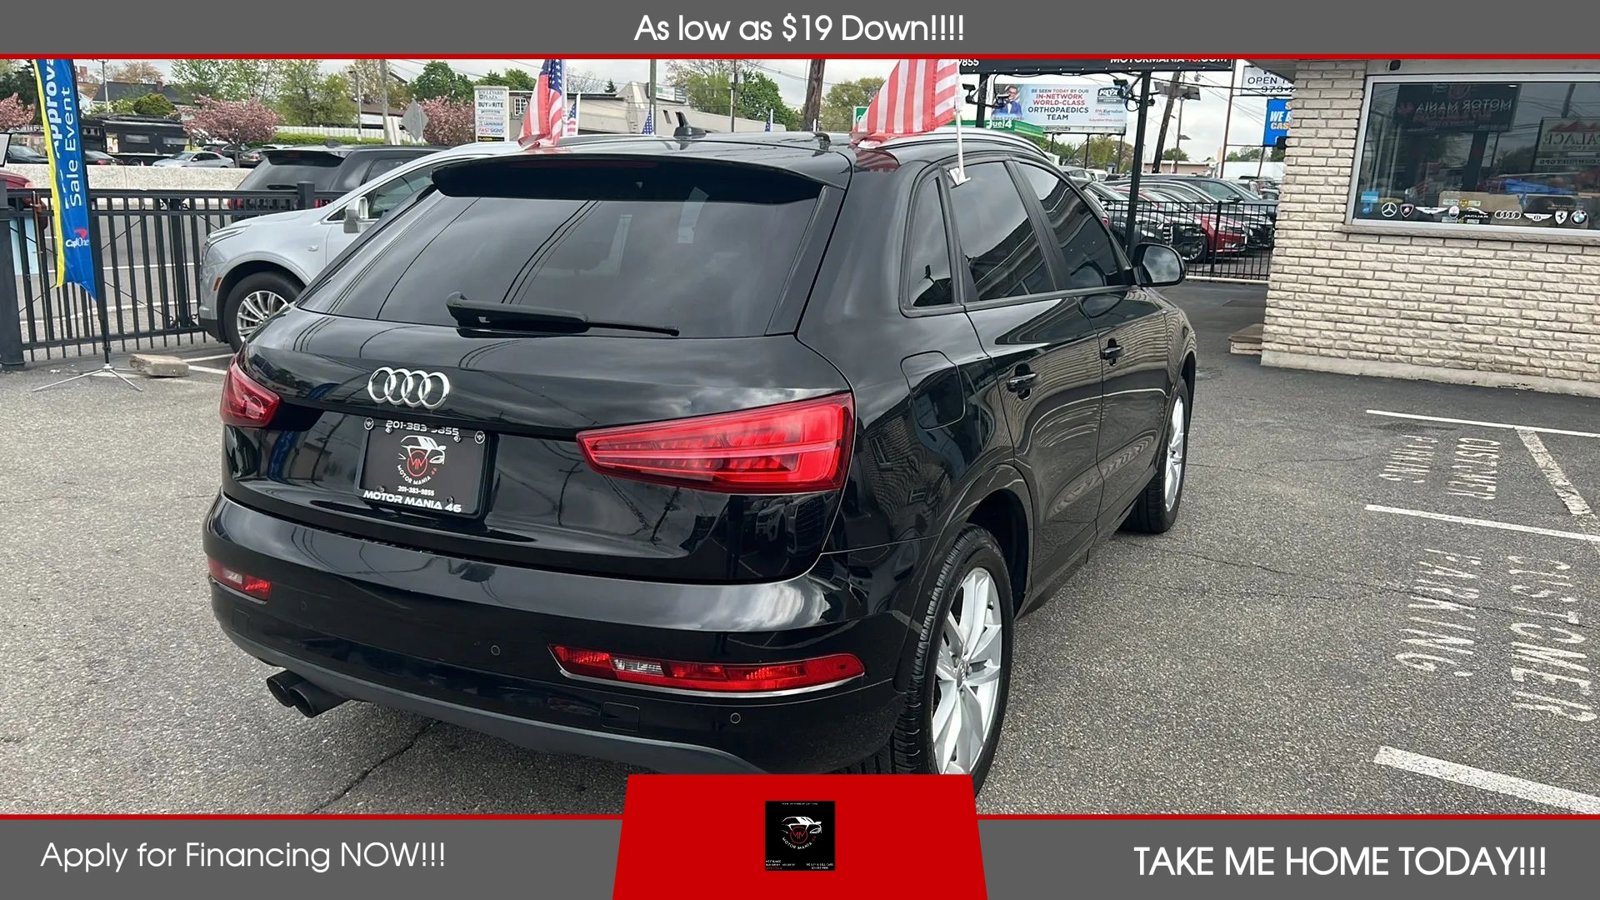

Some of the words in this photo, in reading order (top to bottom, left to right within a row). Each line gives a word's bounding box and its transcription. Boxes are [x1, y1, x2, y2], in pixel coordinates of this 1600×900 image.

[1247, 76, 1278, 84] OPEN
[61, 86, 76, 151] Event
[1270, 111, 1284, 122] WE
[66, 159, 82, 206] Sale
[397, 464, 412, 484] MOTOR
[413, 476, 432, 485] MANIA
[363, 490, 403, 504] MOTOR
[404, 496, 442, 510] MANIA
[444, 503, 462, 512] 46
